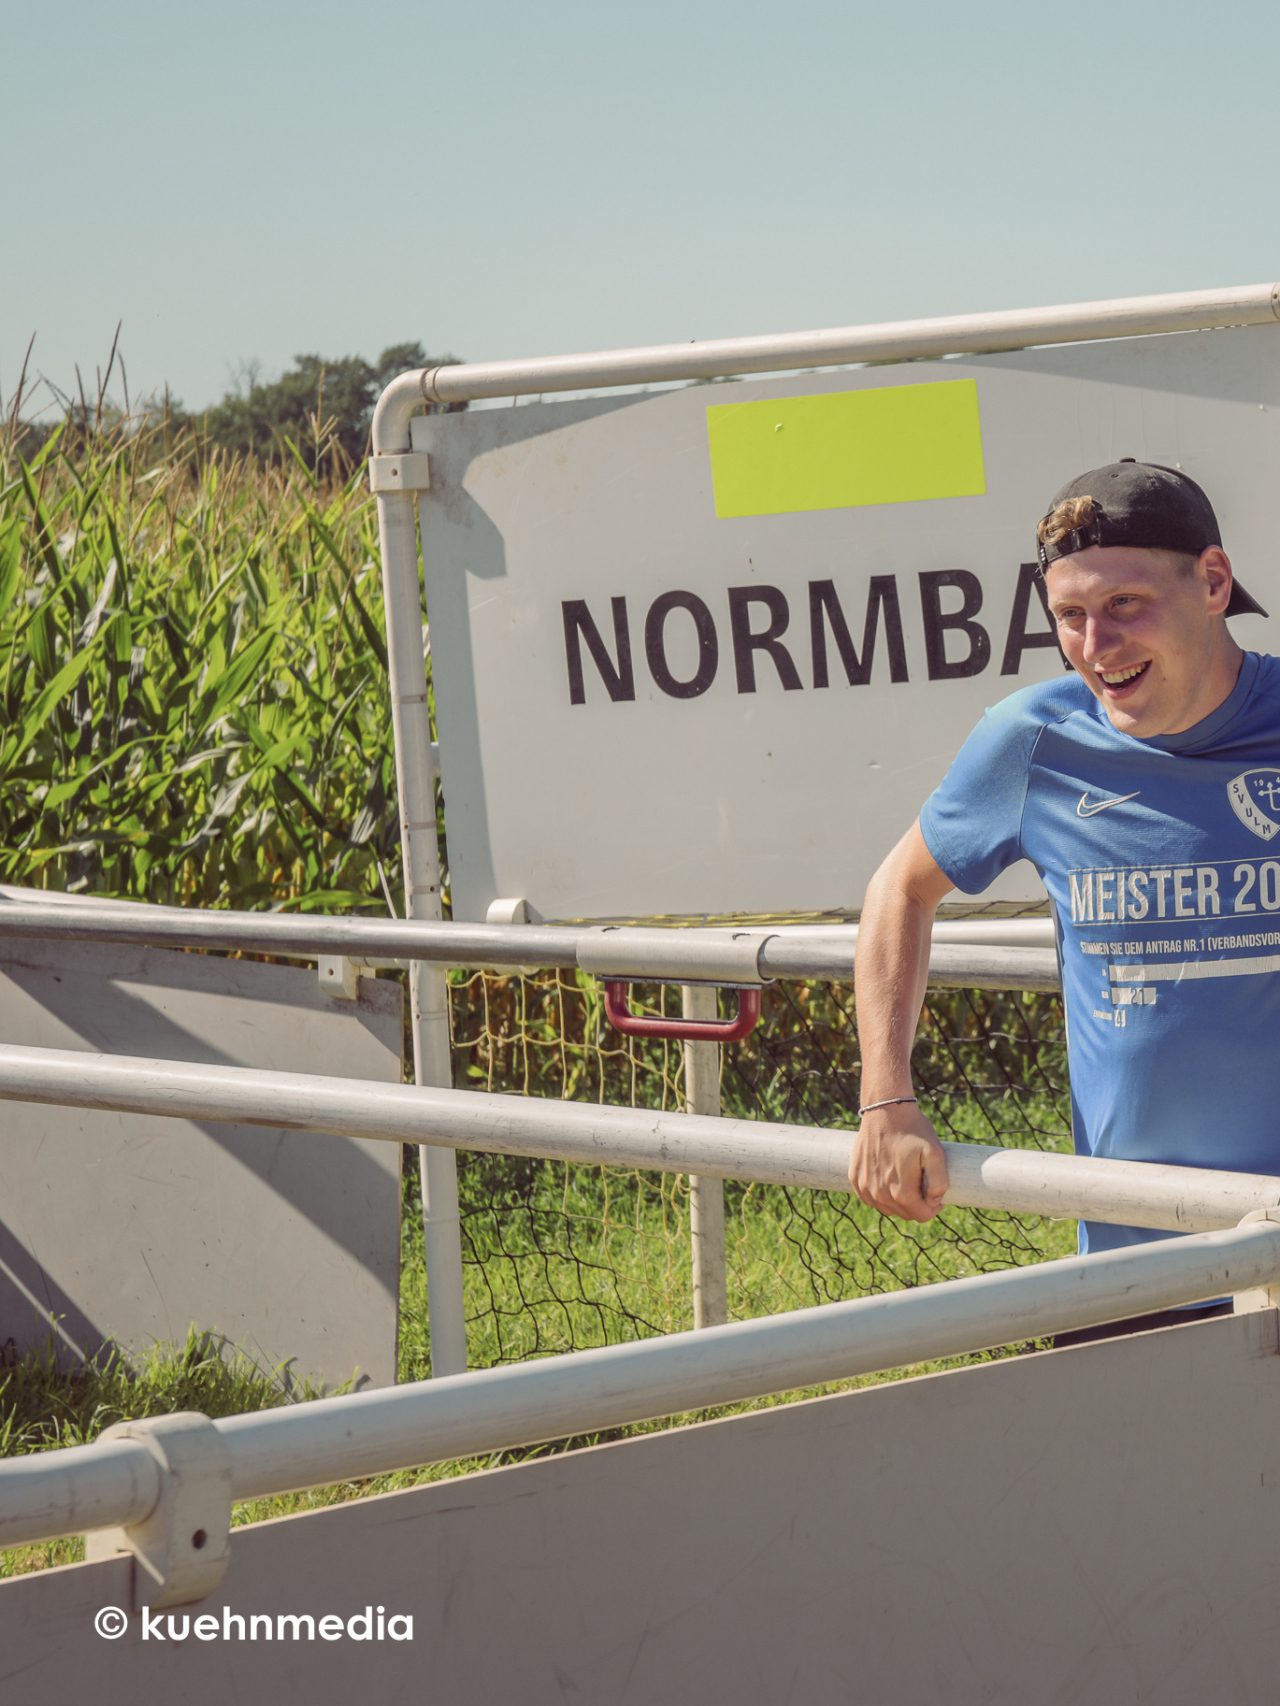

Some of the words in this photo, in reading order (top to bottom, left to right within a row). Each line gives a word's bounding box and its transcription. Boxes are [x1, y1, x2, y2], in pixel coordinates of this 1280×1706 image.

[1069, 867, 1221, 922] MEISTER
[1124, 942, 1143, 955] DEM
[1145, 940, 1182, 954] ANTRAG
[1130, 987, 1145, 1006] 21
